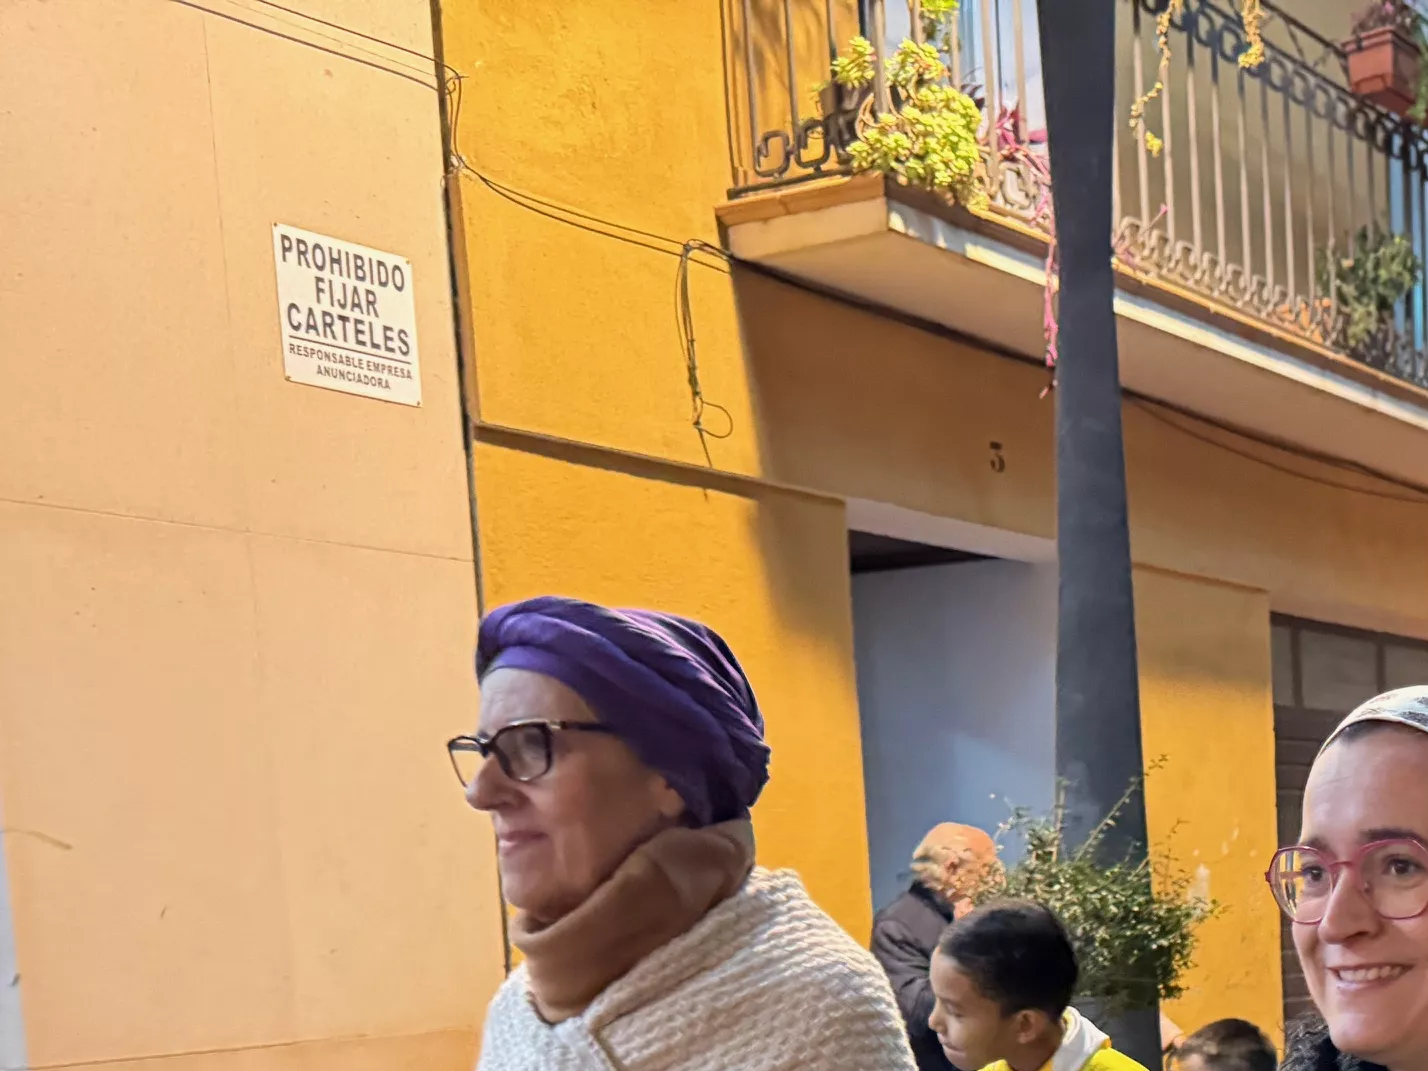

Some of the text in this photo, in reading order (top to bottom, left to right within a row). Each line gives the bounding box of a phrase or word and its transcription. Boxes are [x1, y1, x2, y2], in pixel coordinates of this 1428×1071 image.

[280, 233, 405, 292] PROHIBIDO
[314, 276, 379, 318] FIJAR
[287, 302, 410, 356] CARTELES
[289, 343, 413, 380] RESPONSABLE EMPRESA
[316, 364, 391, 390] ANUNCIADORA
